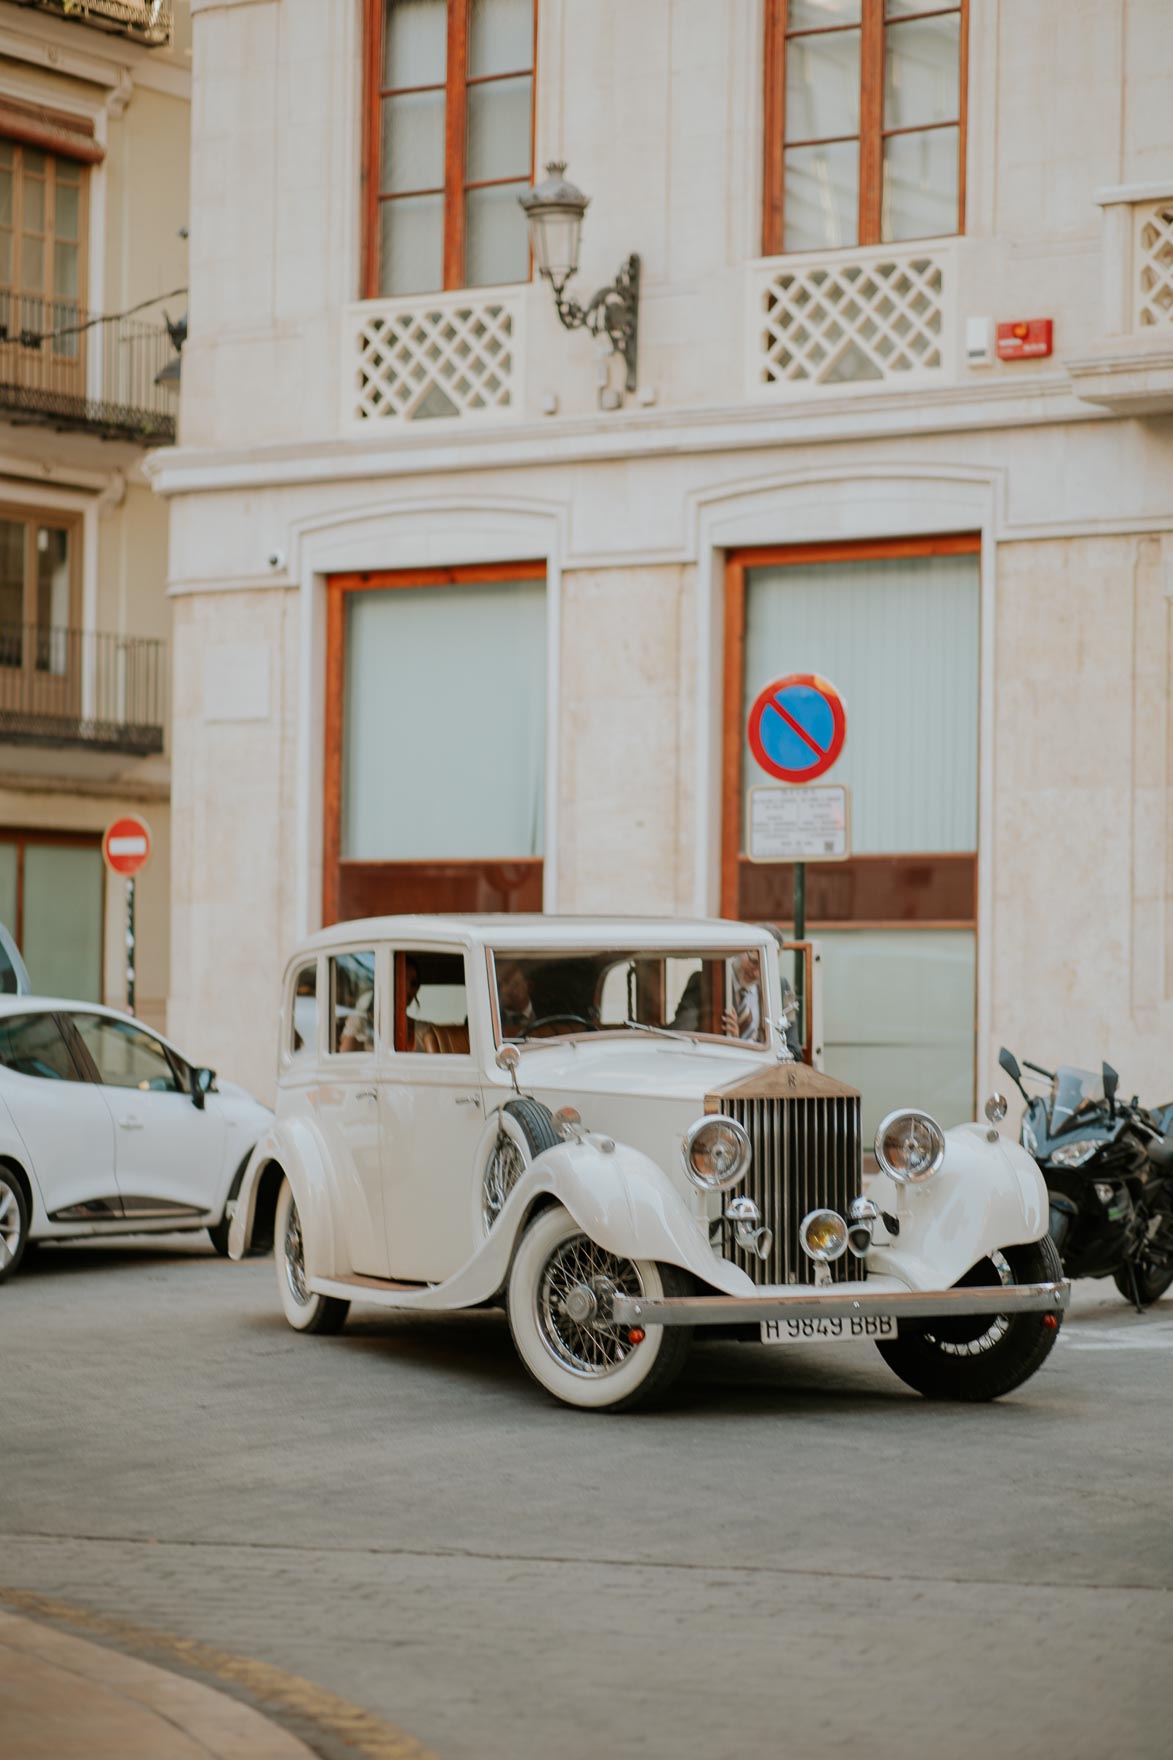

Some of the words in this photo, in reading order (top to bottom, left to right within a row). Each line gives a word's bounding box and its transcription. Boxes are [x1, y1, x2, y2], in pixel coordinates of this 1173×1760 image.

[766, 1320, 779, 1338] H
[787, 1318, 843, 1337] 9849
[850, 1316, 892, 1335] BBB
